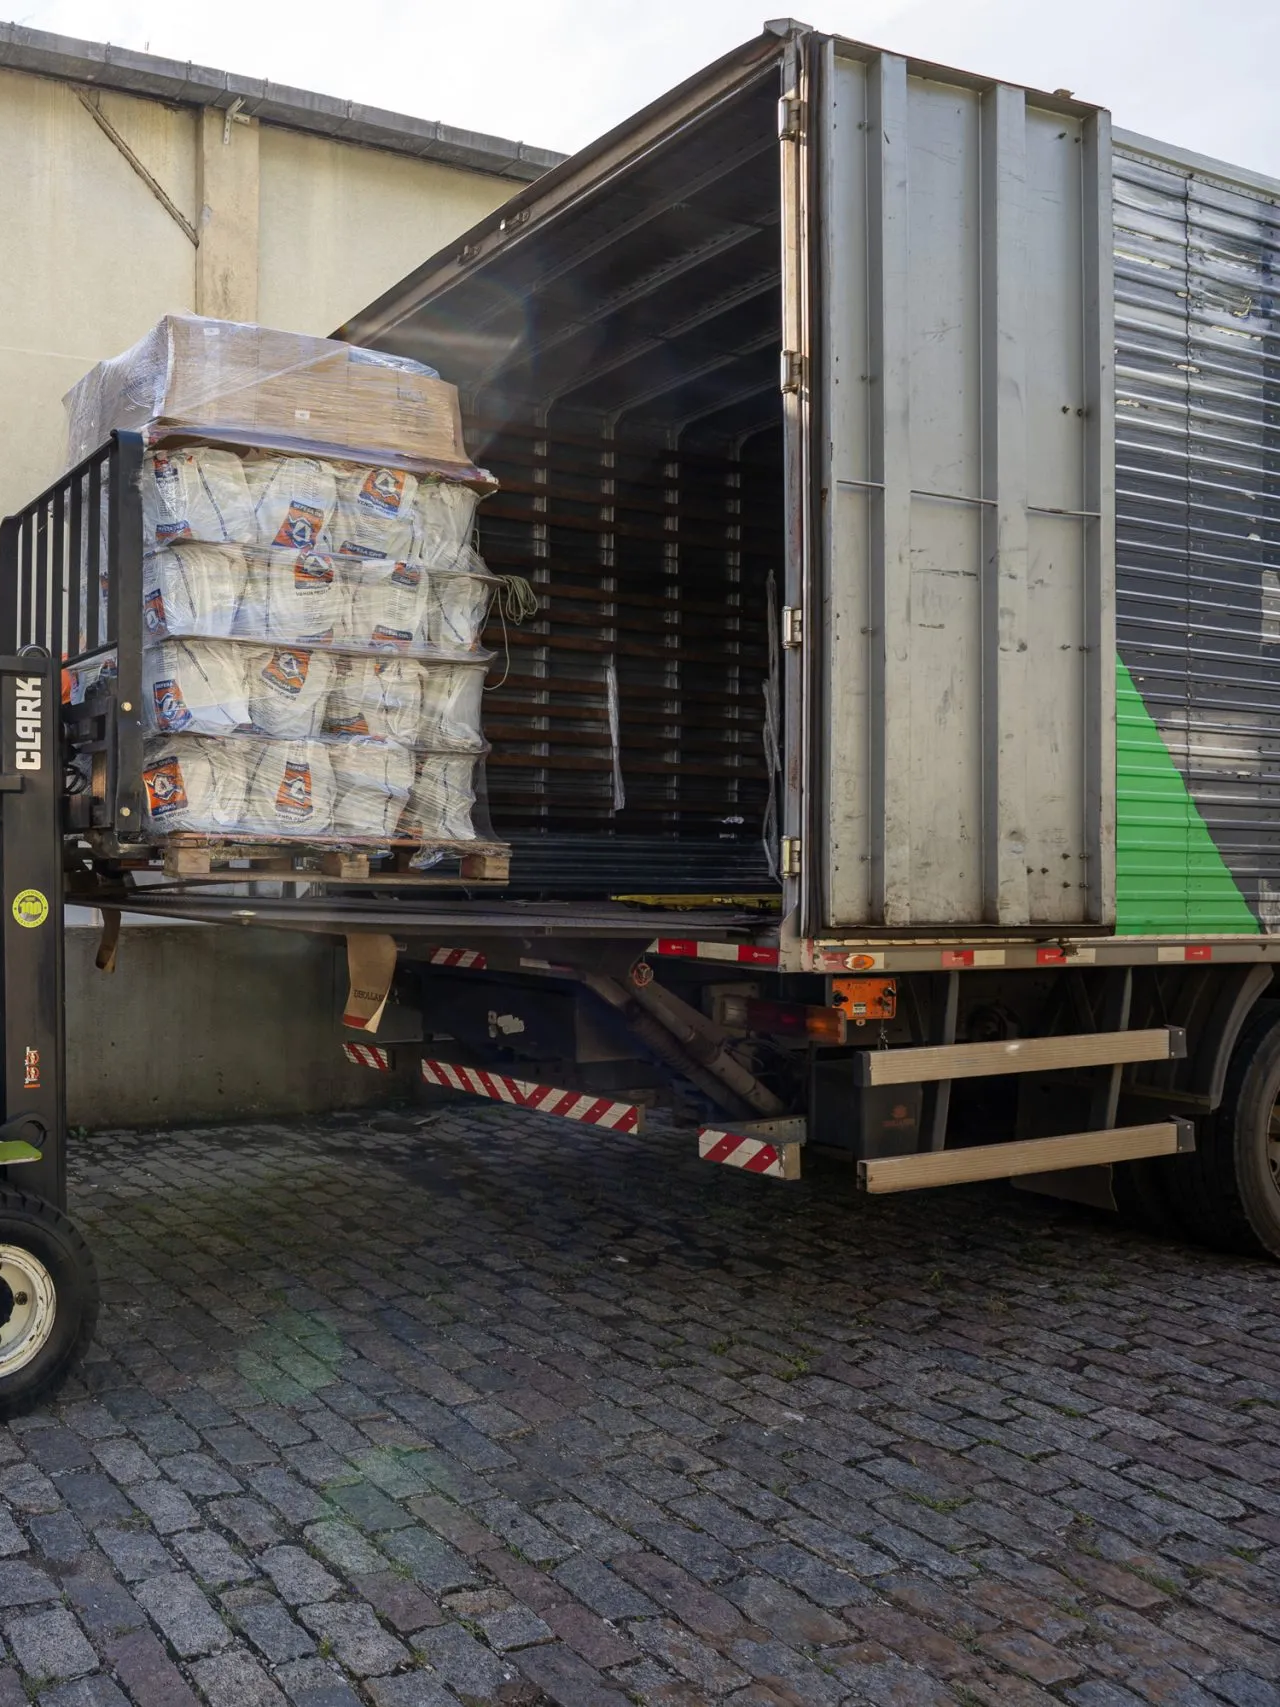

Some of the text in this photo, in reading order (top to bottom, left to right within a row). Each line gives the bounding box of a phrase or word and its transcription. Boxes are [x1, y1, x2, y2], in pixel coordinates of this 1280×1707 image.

[345, 543, 368, 554] DEFESA
[16, 677, 41, 770] CLARK
[20, 901, 42, 915] 100
